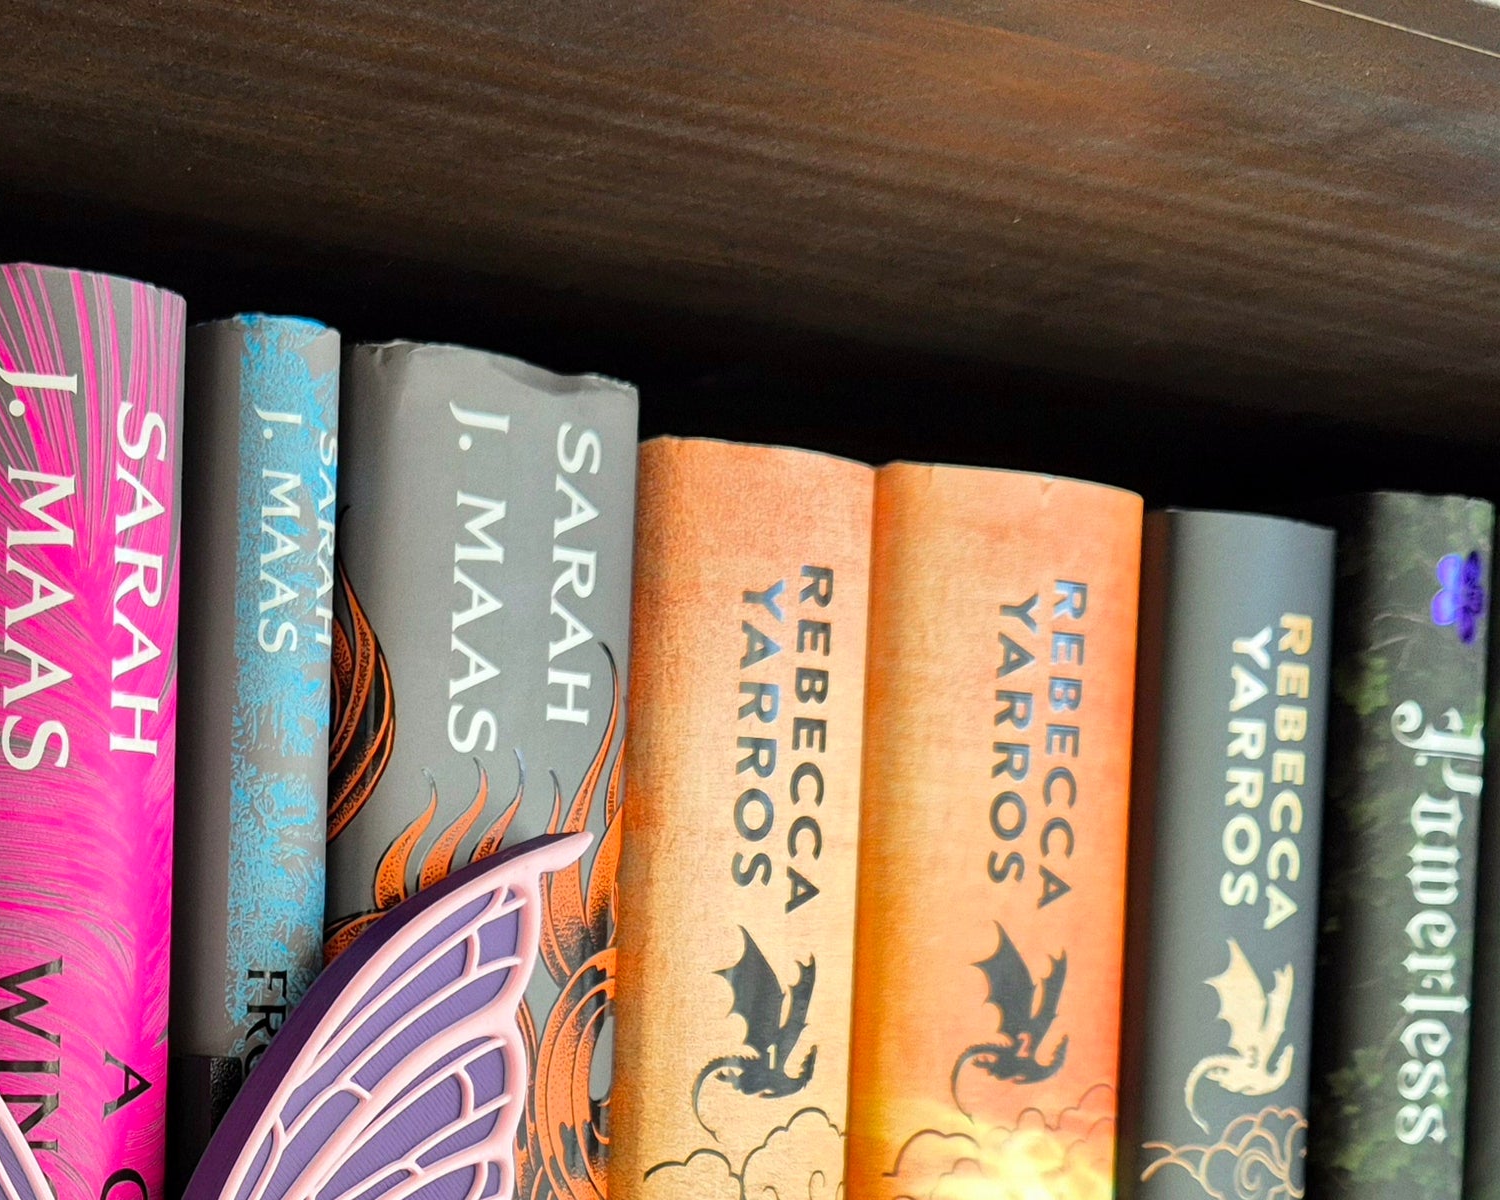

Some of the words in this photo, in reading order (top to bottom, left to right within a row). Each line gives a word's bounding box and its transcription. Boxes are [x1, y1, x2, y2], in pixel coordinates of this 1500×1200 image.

[254, 404, 303, 440] J.
[258, 469, 302, 655] MAAS
[315, 430, 339, 649] SARAH
[449, 401, 510, 452] J.
[2, 464, 77, 771] MAAS
[108, 400, 168, 758] SARAH
[447, 490, 507, 754] MAAS
[546, 421, 602, 726] SARAH
[731, 578, 787, 888] YARROS
[784, 564, 835, 915] REBECCA
[987, 592, 1040, 885] YARROS
[1037, 578, 1088, 910] REBECCA
[1219, 624, 1273, 907] YARROS
[1263, 612, 1313, 931] REBECCA
[766, 1043, 777, 1070] 1
[1017, 1032, 1031, 1059] 2
[1391, 700, 1485, 1145] Powerless
[102, 1050, 154, 1123] A
